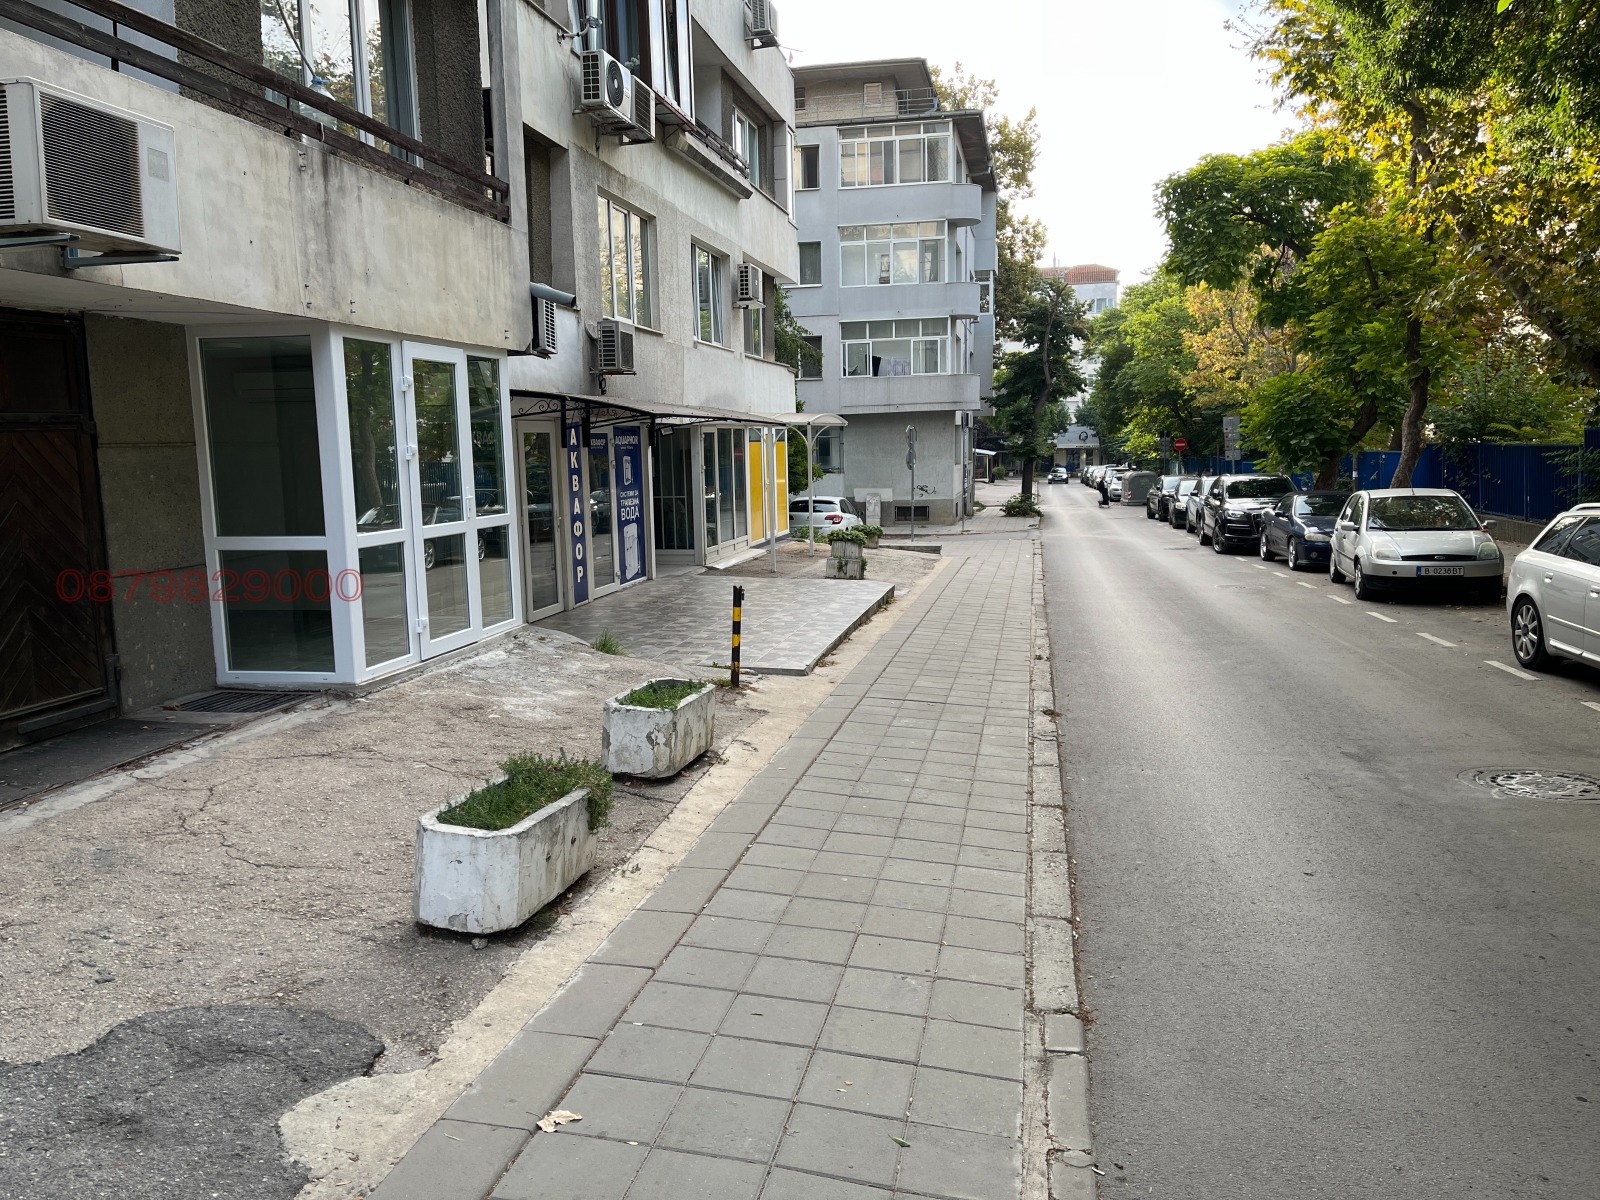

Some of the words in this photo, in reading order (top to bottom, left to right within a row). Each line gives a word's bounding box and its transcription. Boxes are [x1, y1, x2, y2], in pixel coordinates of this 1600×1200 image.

[615, 436, 638, 445] AQUAPHOR
[570, 428, 584, 583] АКВАФОР
[621, 506, 640, 521] ВОДА
